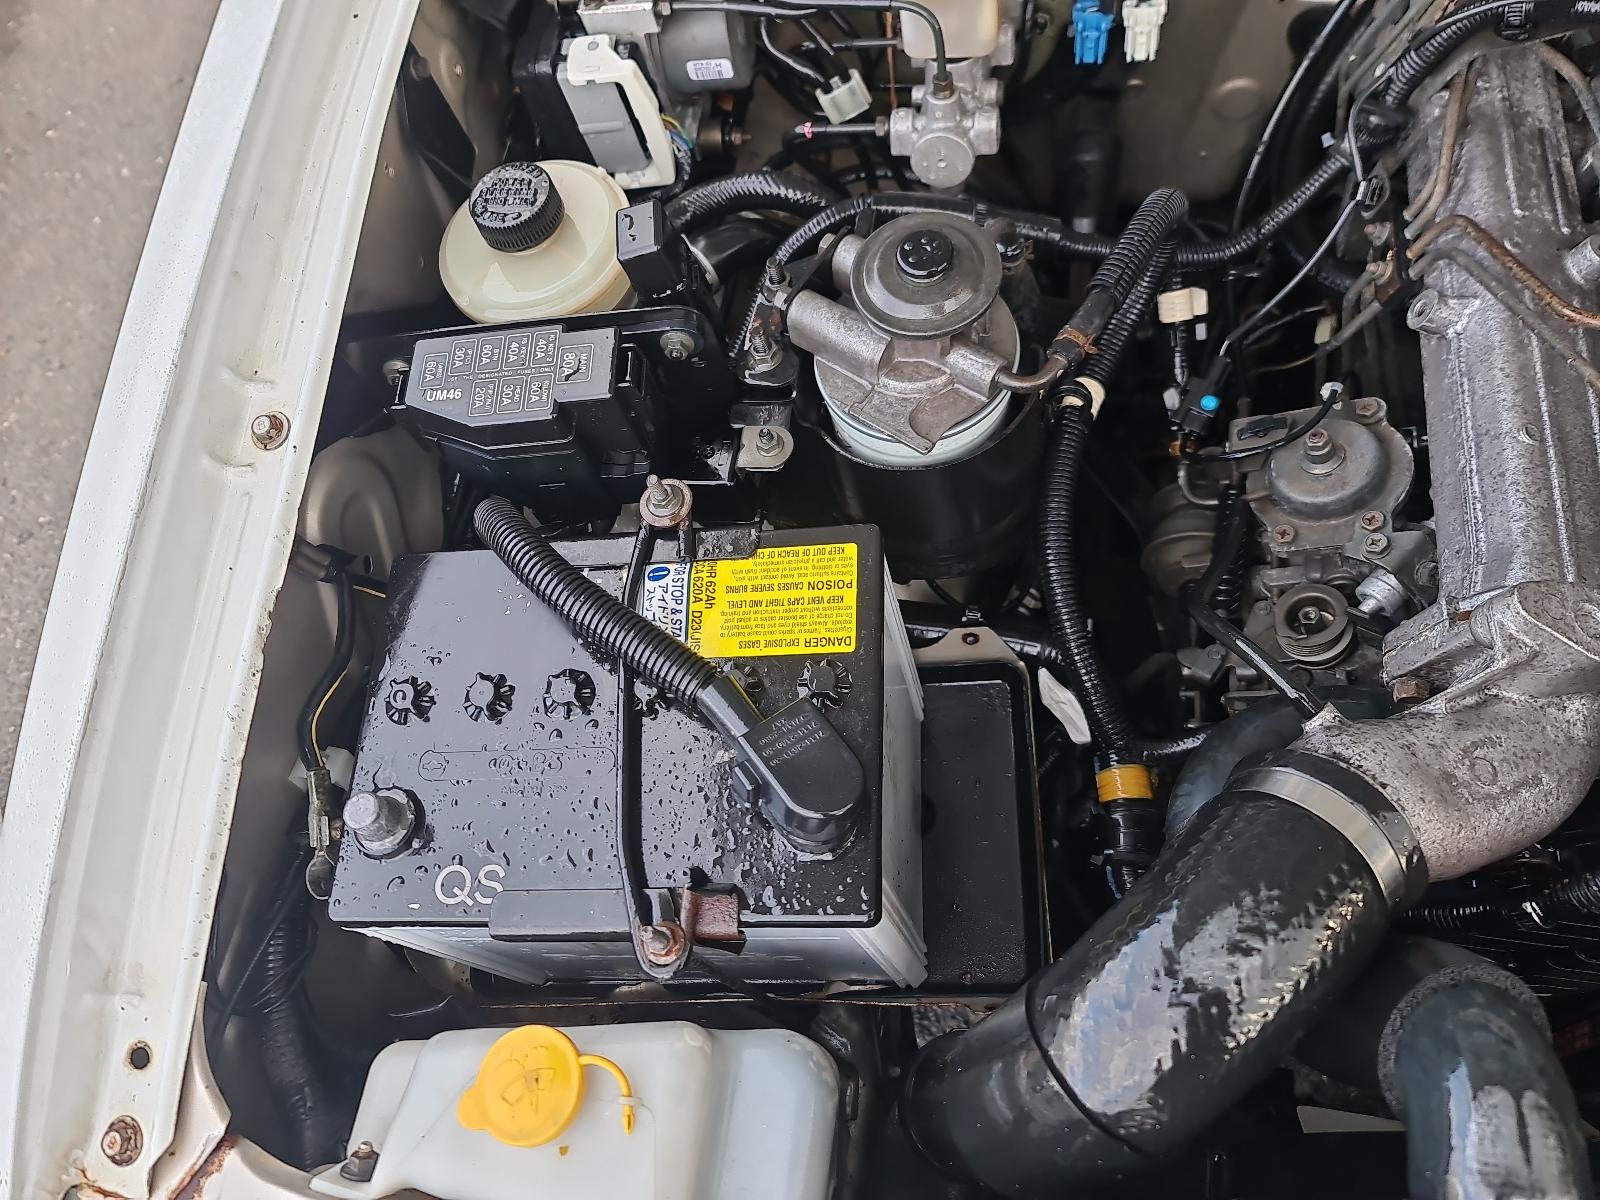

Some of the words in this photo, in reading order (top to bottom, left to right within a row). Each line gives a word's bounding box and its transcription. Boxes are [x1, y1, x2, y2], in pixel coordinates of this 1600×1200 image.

[507, 342, 519, 362] 40A
[534, 339, 546, 359] 40A
[452, 348, 464, 368] 30A
[479, 345, 492, 365] 60A
[560, 352, 575, 376] 80A
[578, 353, 588, 373] MAIN
[424, 362, 436, 382] 60A
[426, 388, 462, 402] UM46
[500, 385, 513, 406] 30A
[529, 381, 541, 403] 60A
[473, 388, 486, 408] 20A
[767, 550, 775, 559] OF
[778, 549, 799, 558] REACH
[802, 549, 810, 557] OF
[813, 547, 826, 557] OUT
[828, 546, 845, 556] KEEP
[673, 563, 687, 576] FOR
[692, 576, 703, 603] 620A
[725, 584, 748, 594] BURNS
[750, 583, 775, 592] SEVERE
[778, 582, 804, 591] CAUSES
[807, 579, 853, 590] POISON
[671, 578, 684, 605] STOP
[705, 581, 716, 609] 62Ah
[727, 600, 746, 609] LEVEL
[748, 600, 763, 608] AND
[766, 598, 785, 607] TIGHT
[787, 597, 805, 606] CAPS
[807, 596, 824, 605] VENT
[827, 595, 844, 604] KEEP
[671, 618, 682, 638] STA
[738, 640, 761, 649] GASES
[764, 638, 800, 648] EXPLOSIVE
[804, 636, 851, 647] DANGER
[434, 864, 504, 906] QS
